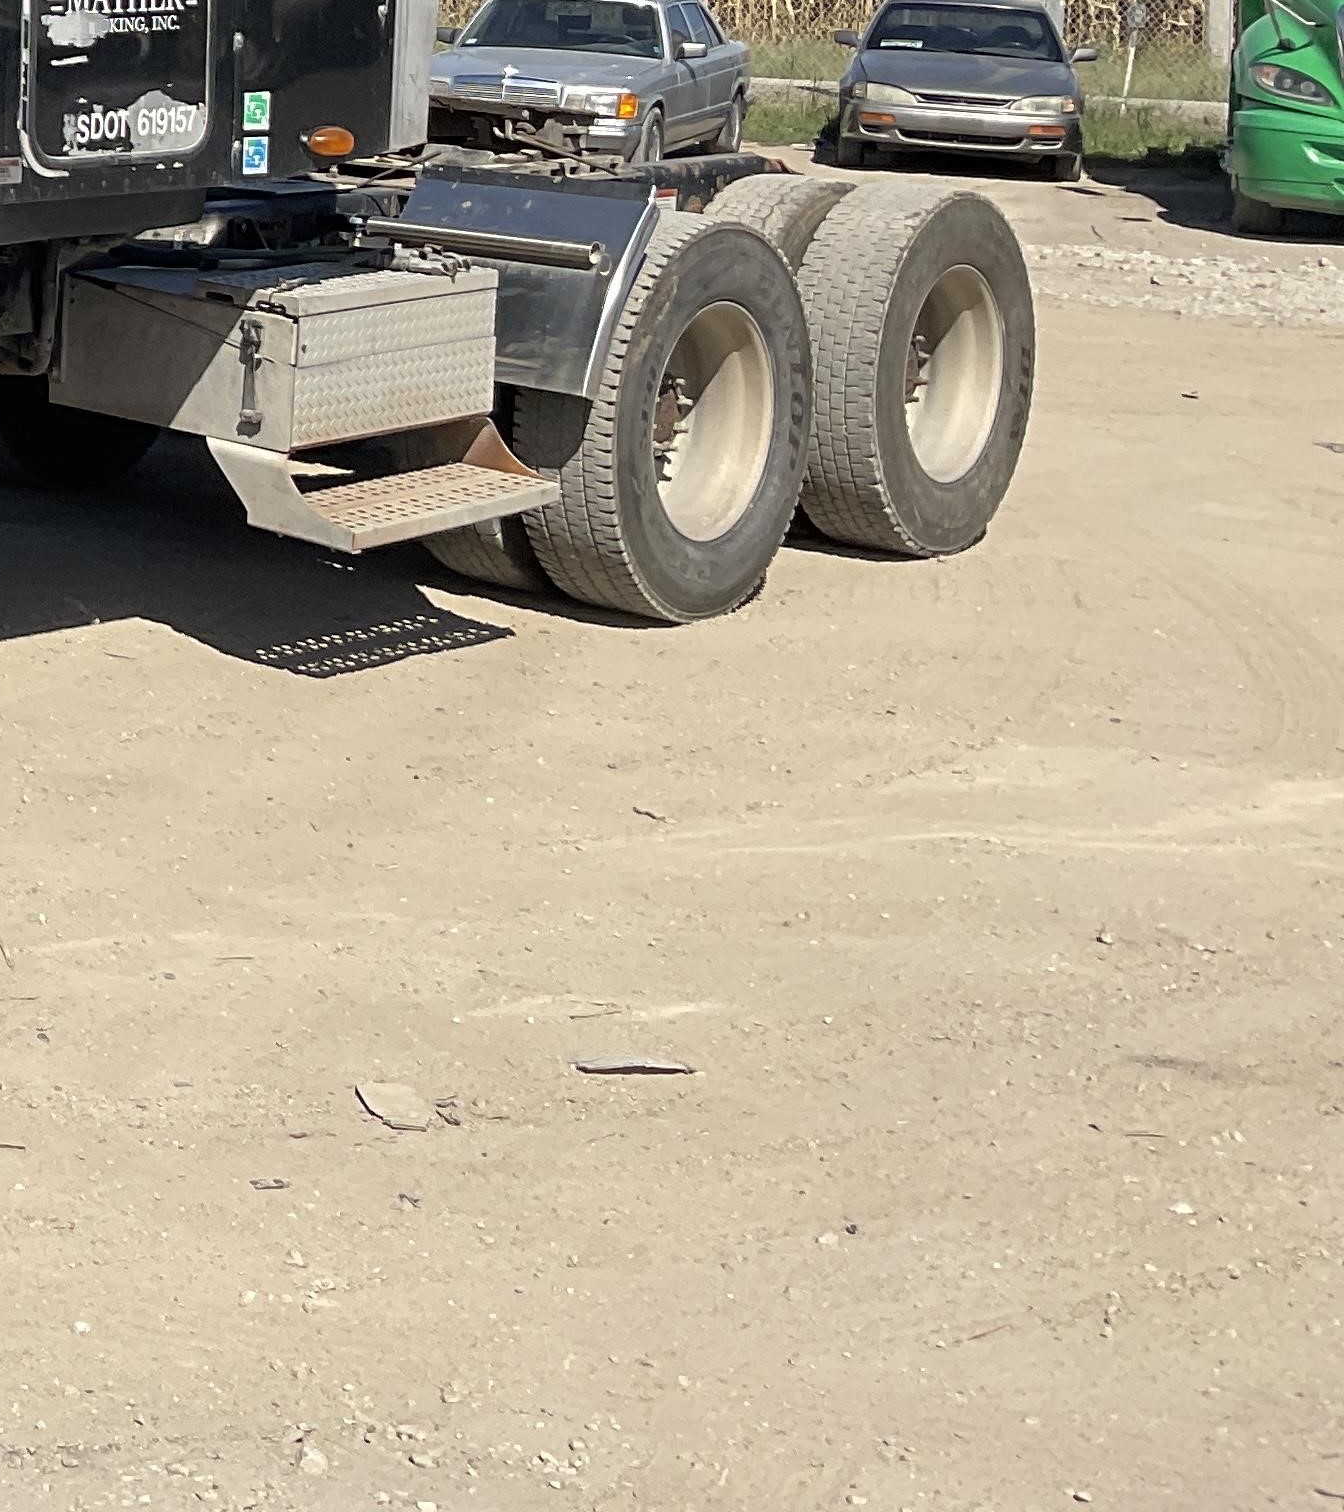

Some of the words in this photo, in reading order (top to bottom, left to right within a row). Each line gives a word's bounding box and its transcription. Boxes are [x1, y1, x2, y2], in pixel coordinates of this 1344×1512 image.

[152, 15, 181, 31] INC.
[76, 109, 130, 144] SDOT
[137, 105, 197, 136] 619157
